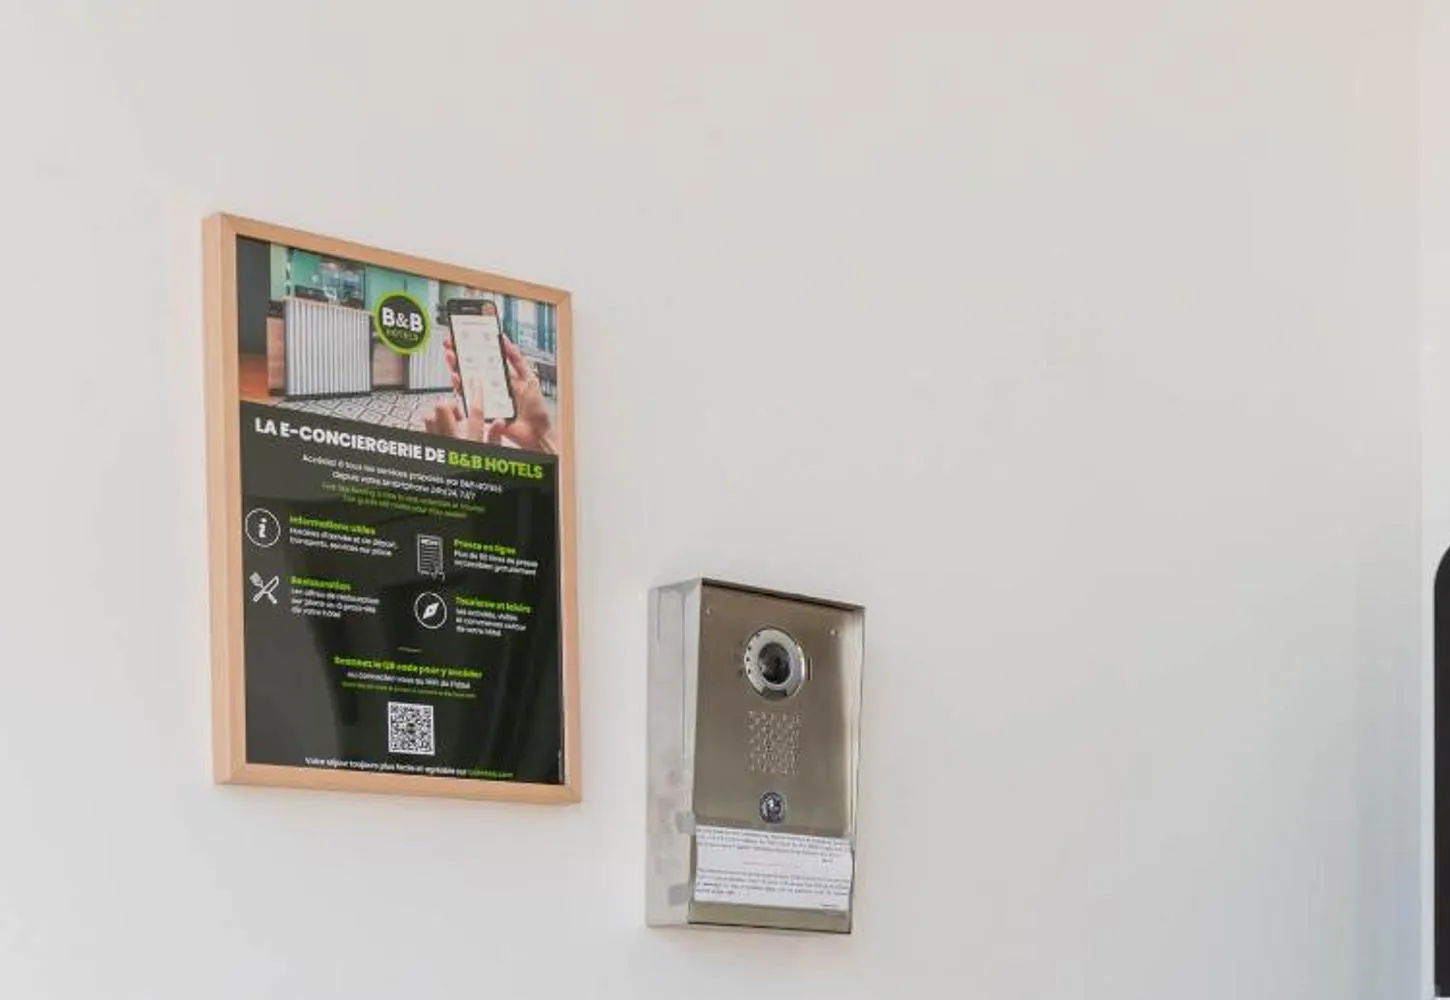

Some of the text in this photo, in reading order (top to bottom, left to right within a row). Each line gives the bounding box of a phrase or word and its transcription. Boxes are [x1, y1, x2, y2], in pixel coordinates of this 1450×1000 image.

[382, 306, 424, 332] B&B
[254, 416, 543, 479] LA E-CONCIERGERIE DE B&B HOTELS
